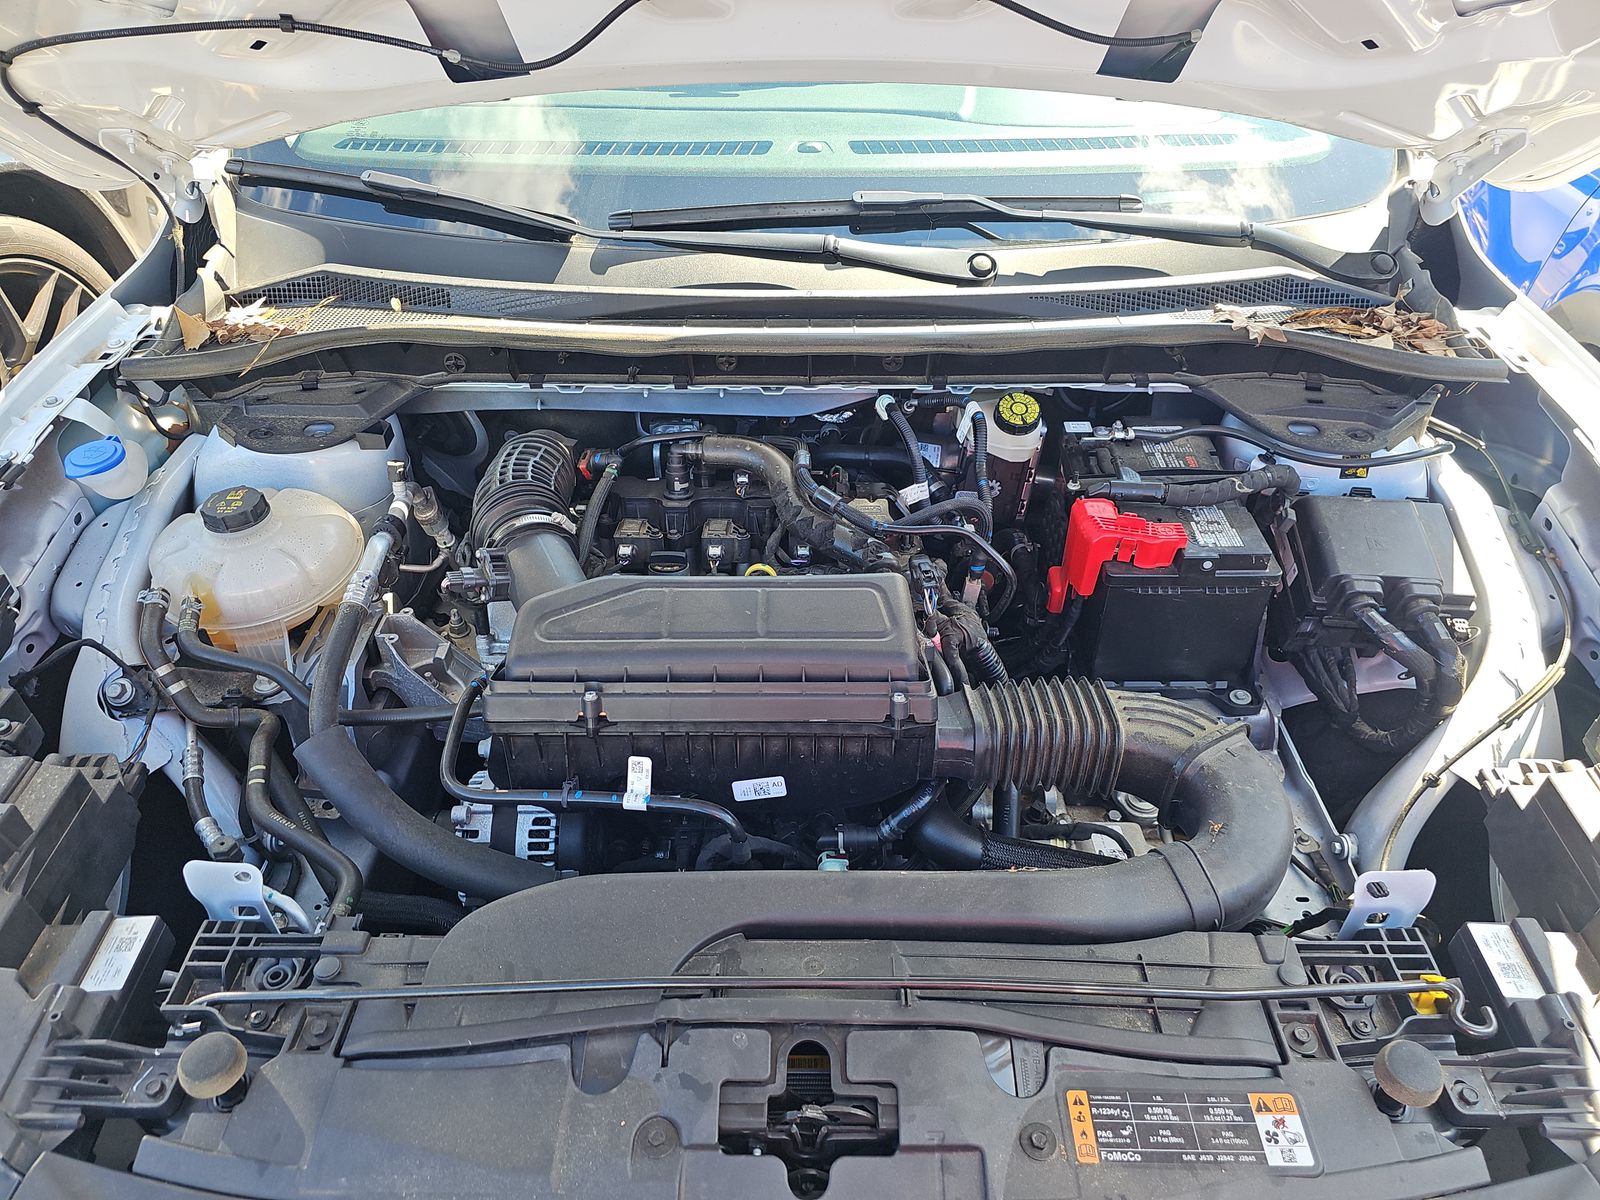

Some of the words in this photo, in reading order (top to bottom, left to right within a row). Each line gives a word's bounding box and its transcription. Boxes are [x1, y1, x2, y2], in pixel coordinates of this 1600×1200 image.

[1091, 1107, 1120, 1116] R-1234yf
[1163, 1107, 1173, 1115] kg
[1208, 1107, 1225, 1115] 0.550
[1225, 1107, 1234, 1116] kg
[1096, 1130, 1113, 1138] PAG
[1100, 1151, 1141, 1161] FoMoCo
